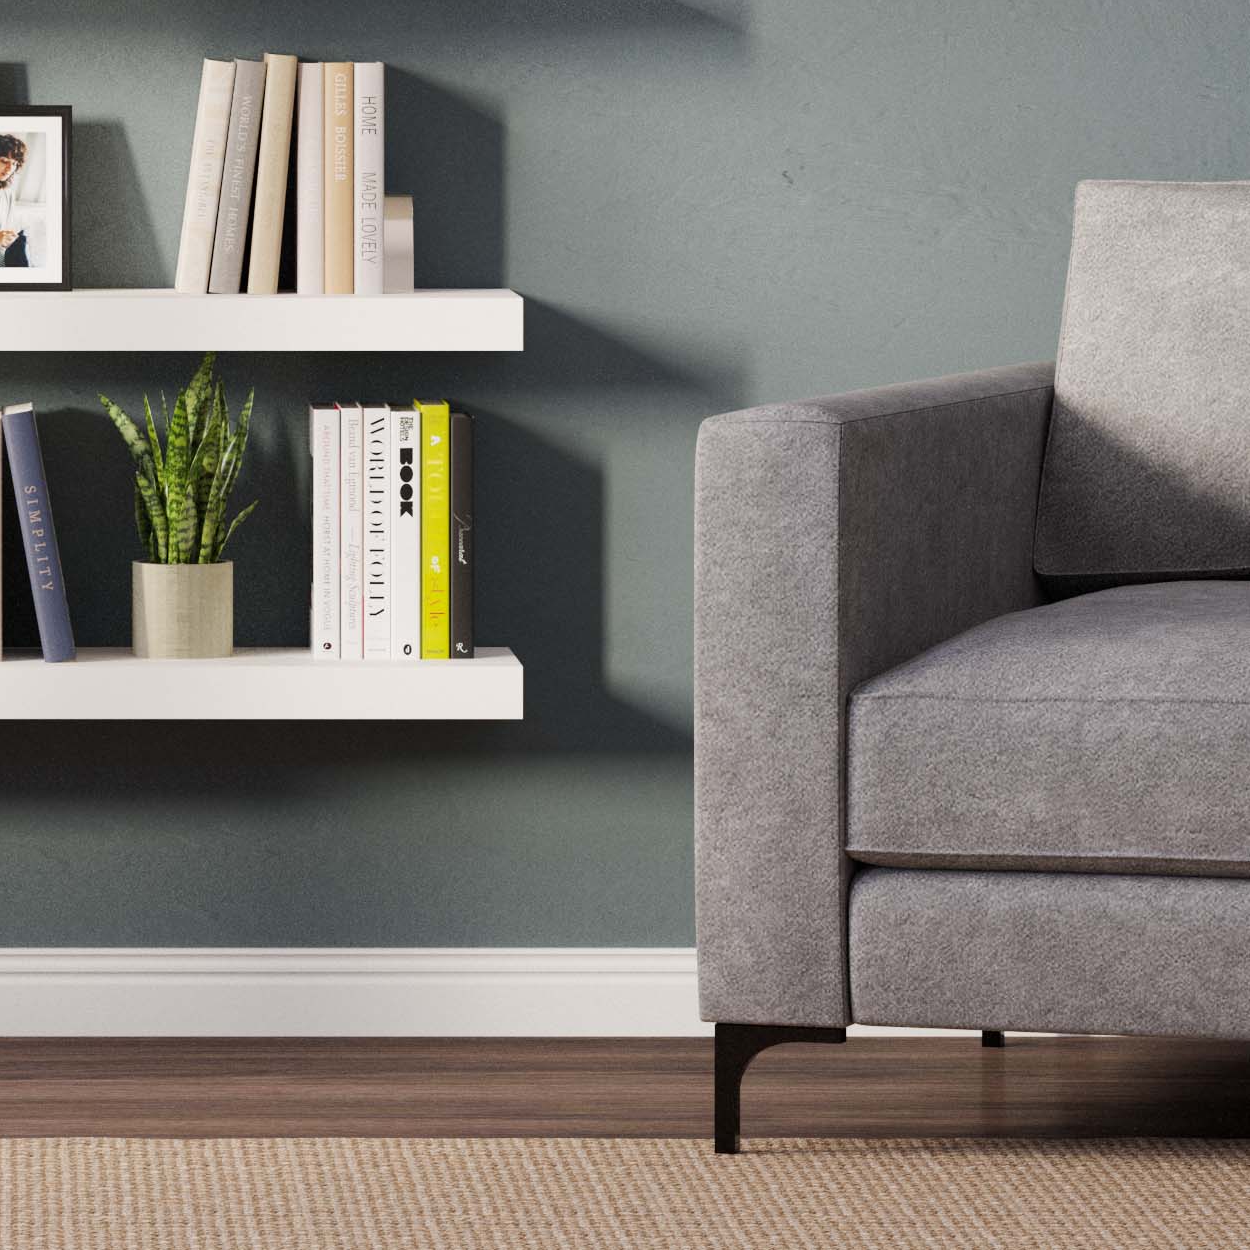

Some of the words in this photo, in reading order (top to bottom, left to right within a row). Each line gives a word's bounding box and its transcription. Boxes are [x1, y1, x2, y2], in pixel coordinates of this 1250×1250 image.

[361, 96, 377, 135] HOME
[229, 158, 246, 201] FINEST
[361, 172, 377, 210] MADE
[223, 206, 240, 254] HOMES
[361, 217, 377, 264] LOVELY
[370, 417, 385, 505] WORLD
[430, 435, 441, 446] A
[400, 448, 414, 517] BOOK
[23, 485, 54, 592] SIMPLITY
[370, 510, 385, 543] OF
[370, 549, 385, 617] FOLLY
